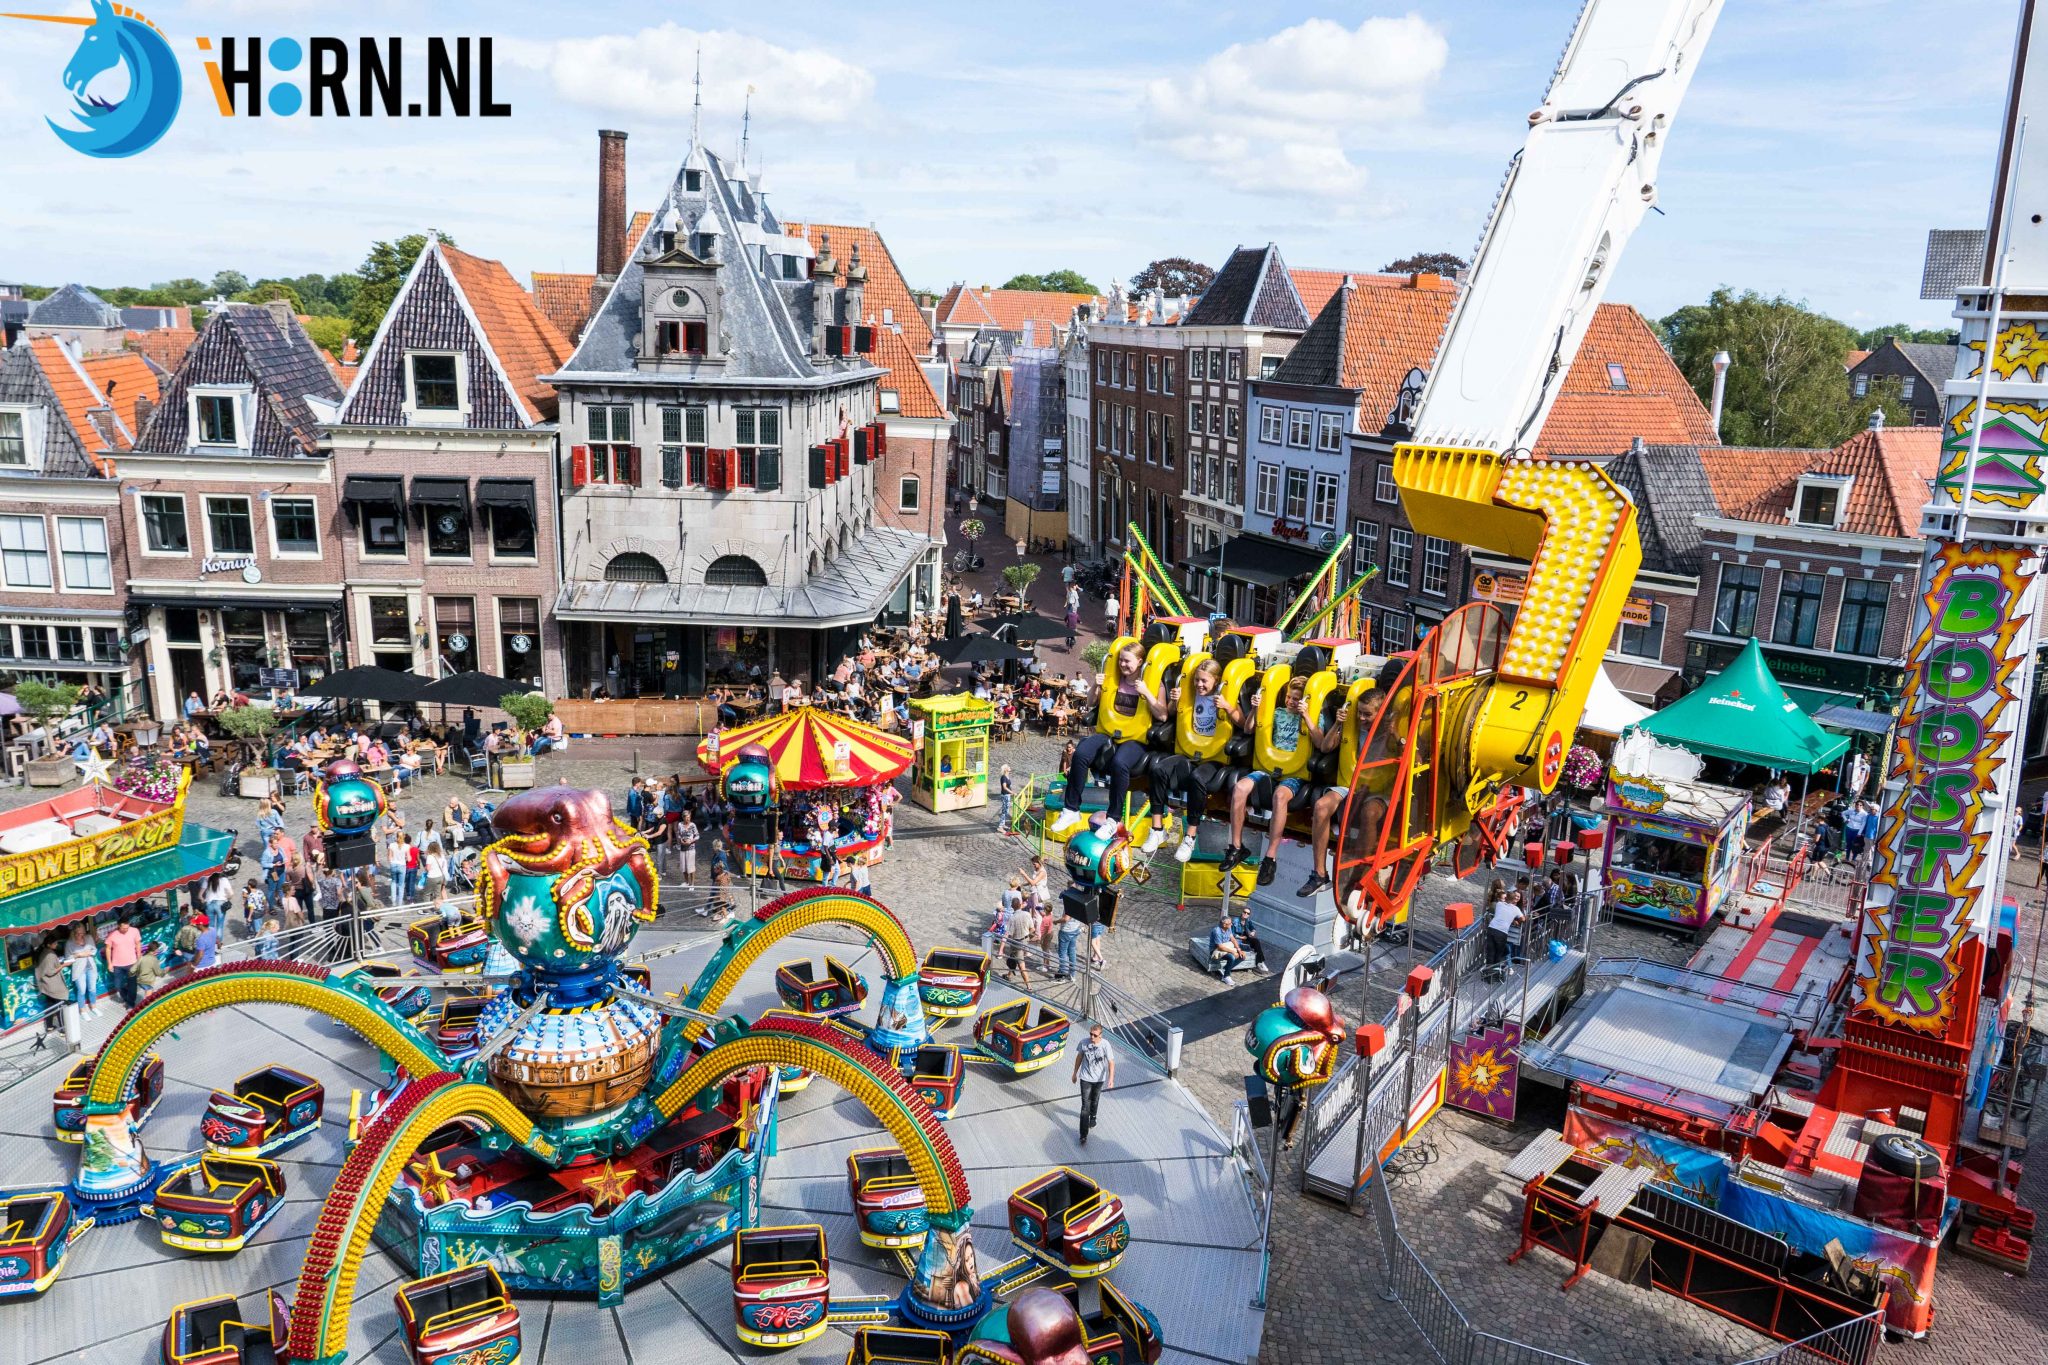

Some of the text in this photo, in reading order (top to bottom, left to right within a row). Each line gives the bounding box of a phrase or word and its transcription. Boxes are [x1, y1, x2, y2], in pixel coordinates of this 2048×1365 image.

[1620, 611, 1649, 621] ENDAG
[1509, 690, 1529, 711] 2
[1708, 697, 1756, 711] Heineken
[1879, 573, 2006, 1018] BOOSTER
[0, 843, 97, 894] POWER
[759, 1278, 810, 1301] Crazy
